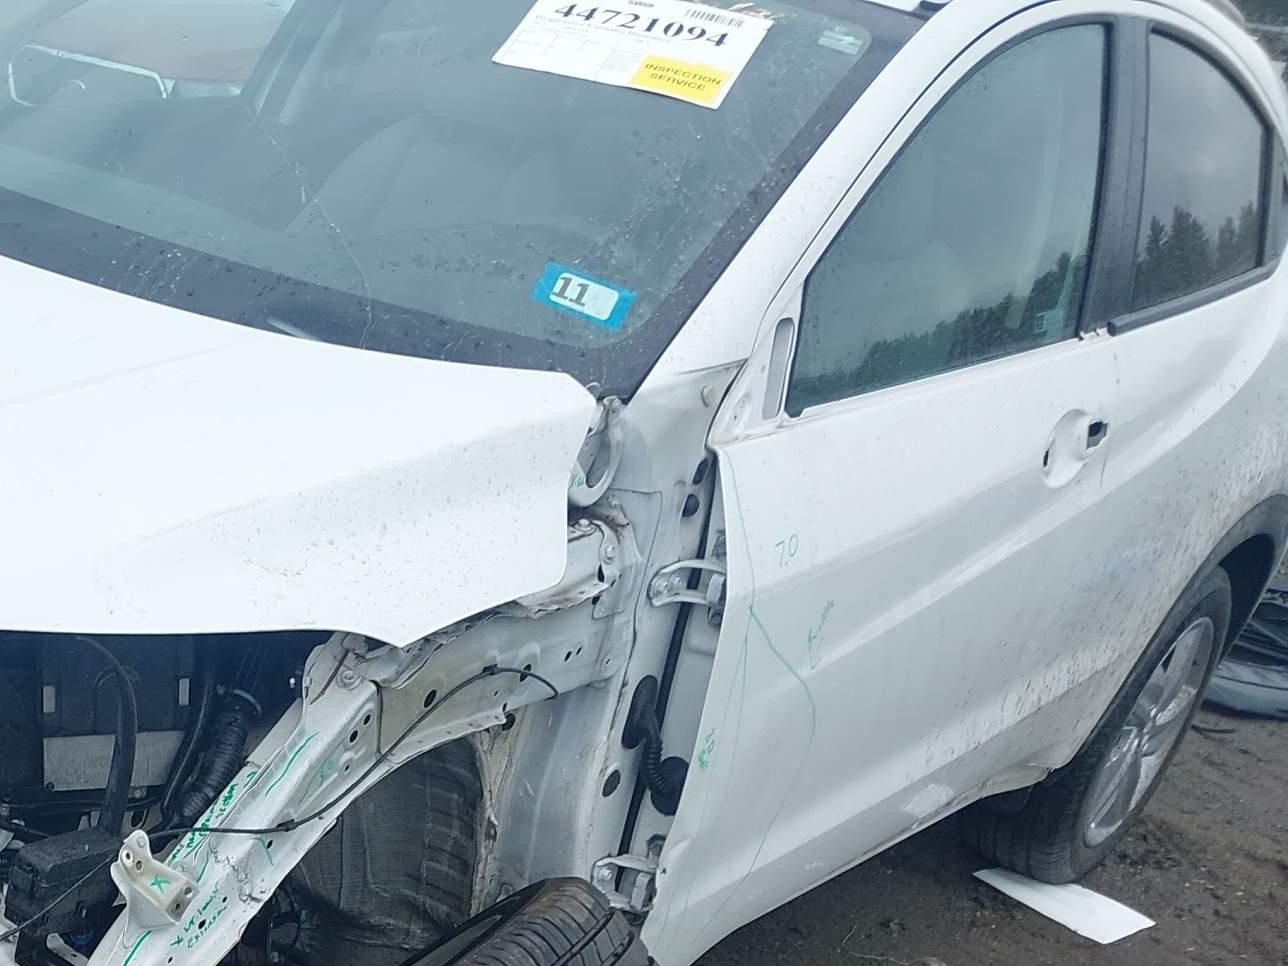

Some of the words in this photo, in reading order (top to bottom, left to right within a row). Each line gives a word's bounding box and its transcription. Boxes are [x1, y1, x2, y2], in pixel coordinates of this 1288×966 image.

[554, 2, 729, 47] 44721094
[644, 62, 723, 86] INSPECTION
[648, 72, 707, 91] SERVICE
[552, 276, 591, 308] 11
